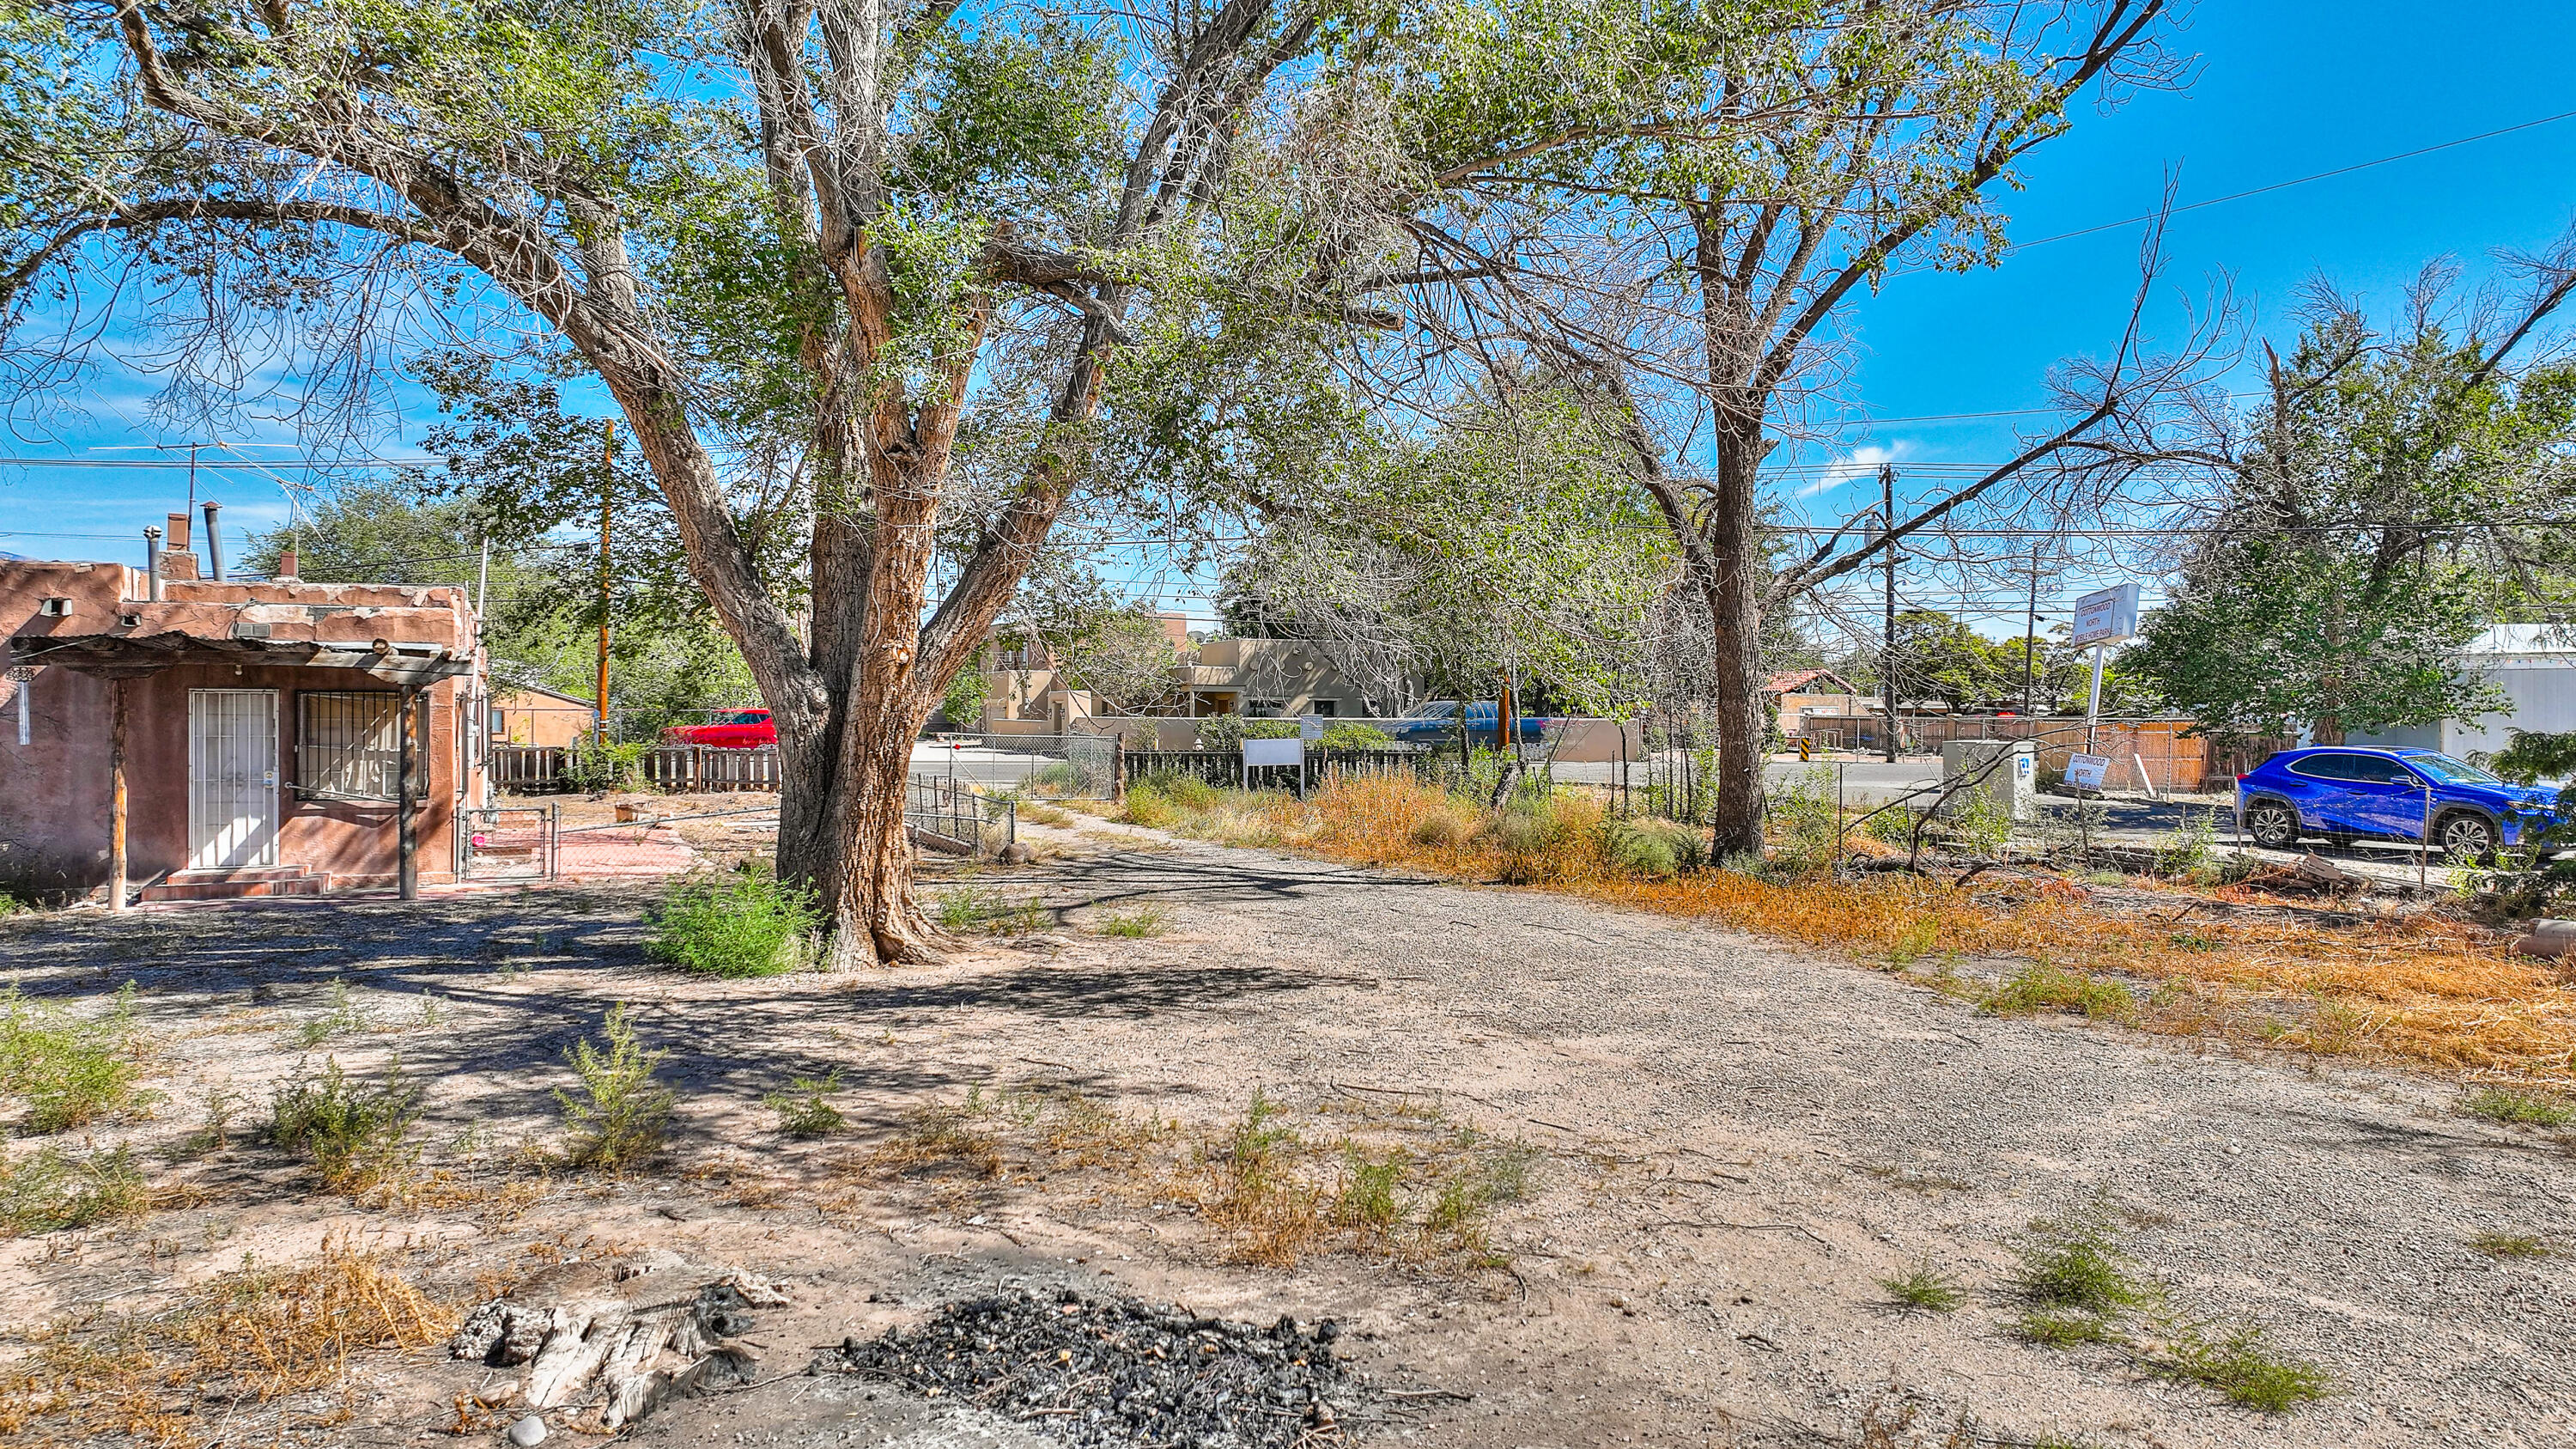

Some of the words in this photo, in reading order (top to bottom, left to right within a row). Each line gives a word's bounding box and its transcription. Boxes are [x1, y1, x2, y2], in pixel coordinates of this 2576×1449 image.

[2081, 602, 2111, 617] COTTONWOOD
[2086, 617, 2100, 626] NORTH
[2075, 632, 2088, 642] MOBILE
[2088, 630, 2099, 639] HOME
[2099, 627, 2110, 637] PARK
[2073, 755, 2105, 766] COTTONWOOD
